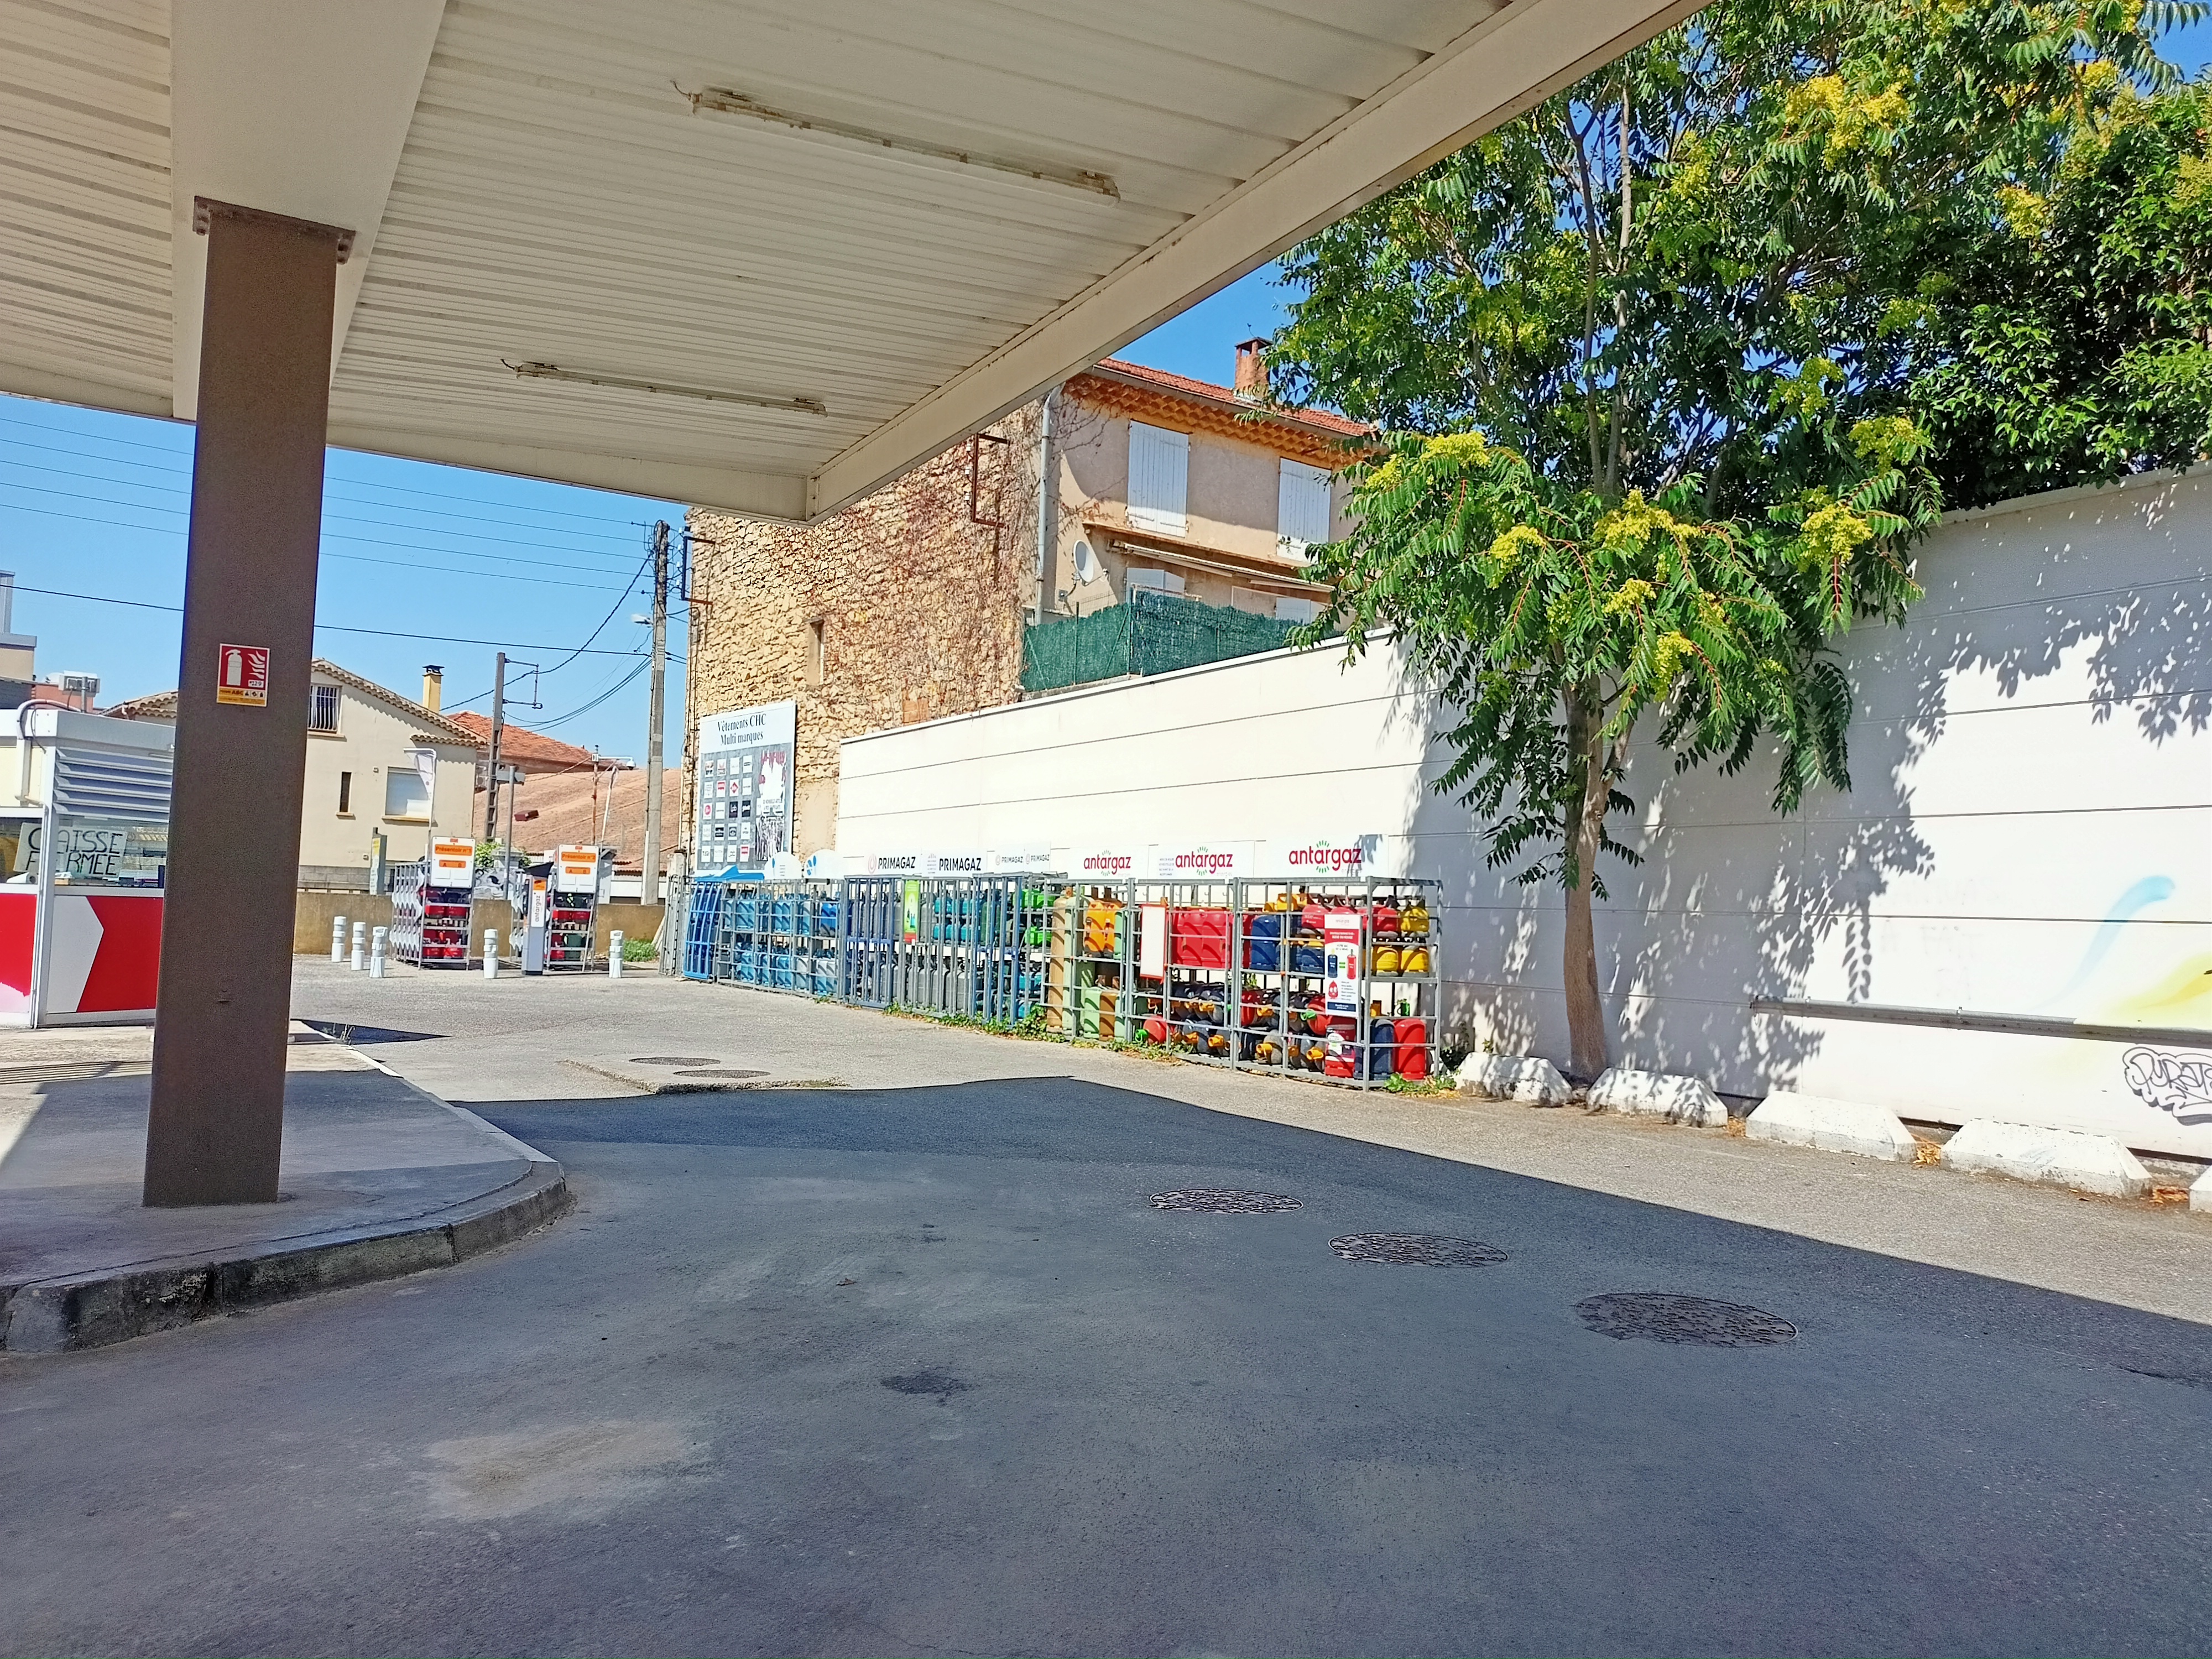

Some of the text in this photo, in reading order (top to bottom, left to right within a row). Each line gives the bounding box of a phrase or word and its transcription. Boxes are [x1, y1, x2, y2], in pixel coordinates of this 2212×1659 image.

[718, 713, 766, 732] Vêtements CHC
[721, 731, 763, 745] Multi marques
[25, 851, 120, 875] FRMEE
[878, 857, 916, 869] PRIMAGAZ
[939, 858, 981, 871] PRIMAGAZ
[1083, 854, 1131, 875] antargaz
[1175, 851, 1233, 874] antargaz
[1289, 846, 1361, 871] antargaz
